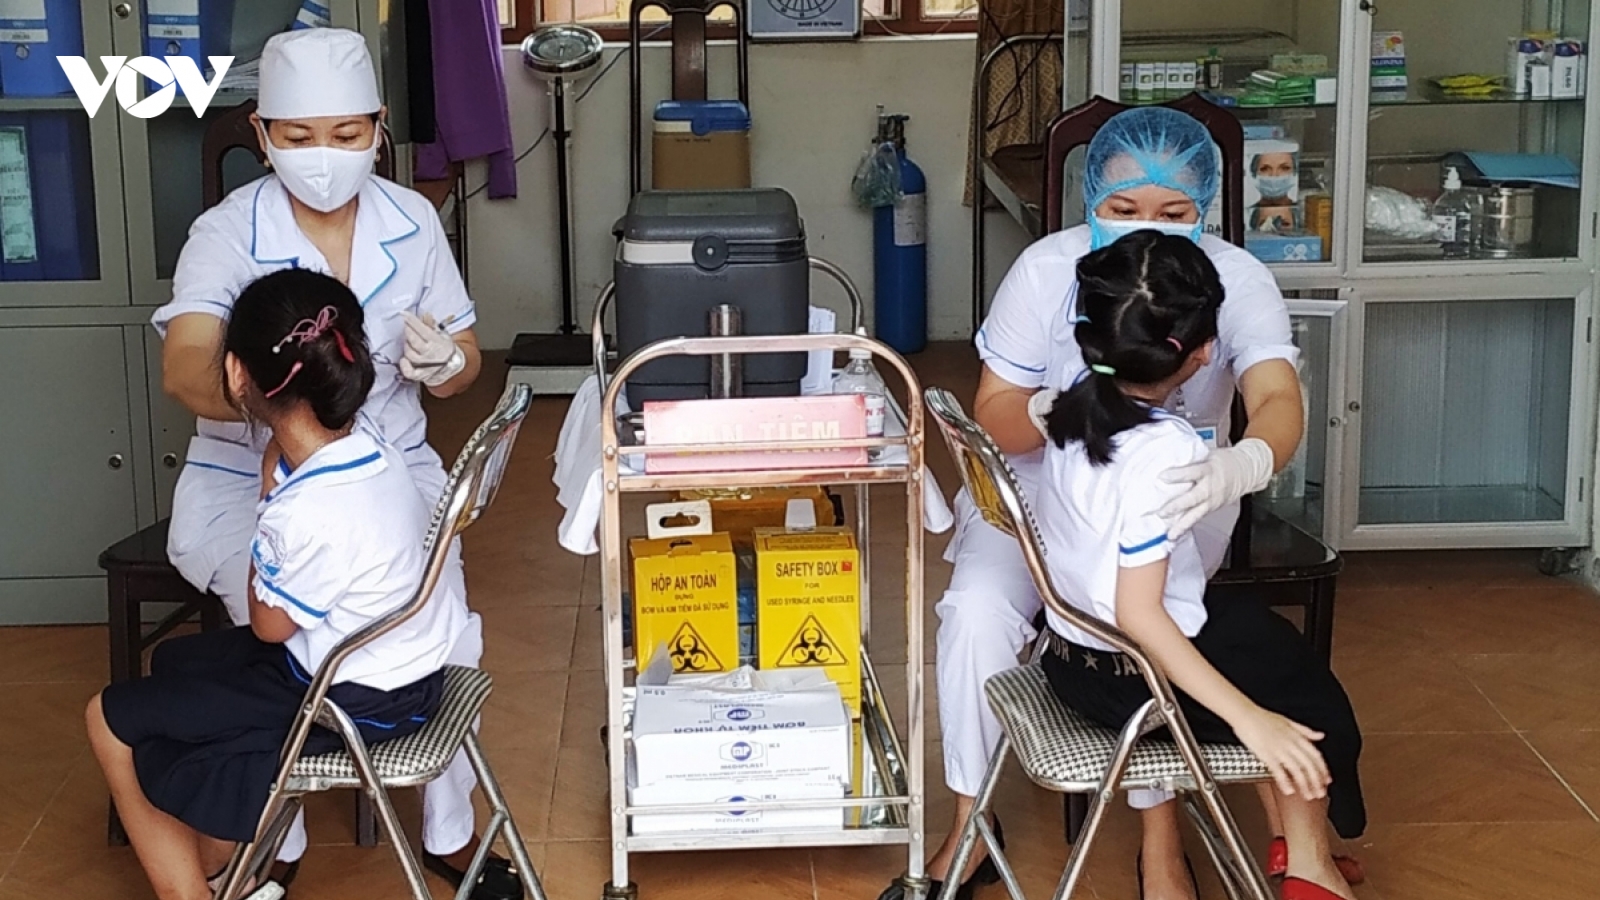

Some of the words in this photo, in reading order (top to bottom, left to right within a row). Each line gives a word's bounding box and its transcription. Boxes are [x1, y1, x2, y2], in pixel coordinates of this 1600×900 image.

[775, 562, 814, 577] SAFETY
[817, 561, 838, 576] BOX
[651, 572, 672, 595] HỘP
[674, 575, 688, 591] AN
[690, 569, 717, 590] TOÀN
[766, 598, 783, 606] USED
[784, 596, 810, 606] SYRINGE
[812, 596, 825, 605] AND
[826, 594, 854, 604] NEEDLES
